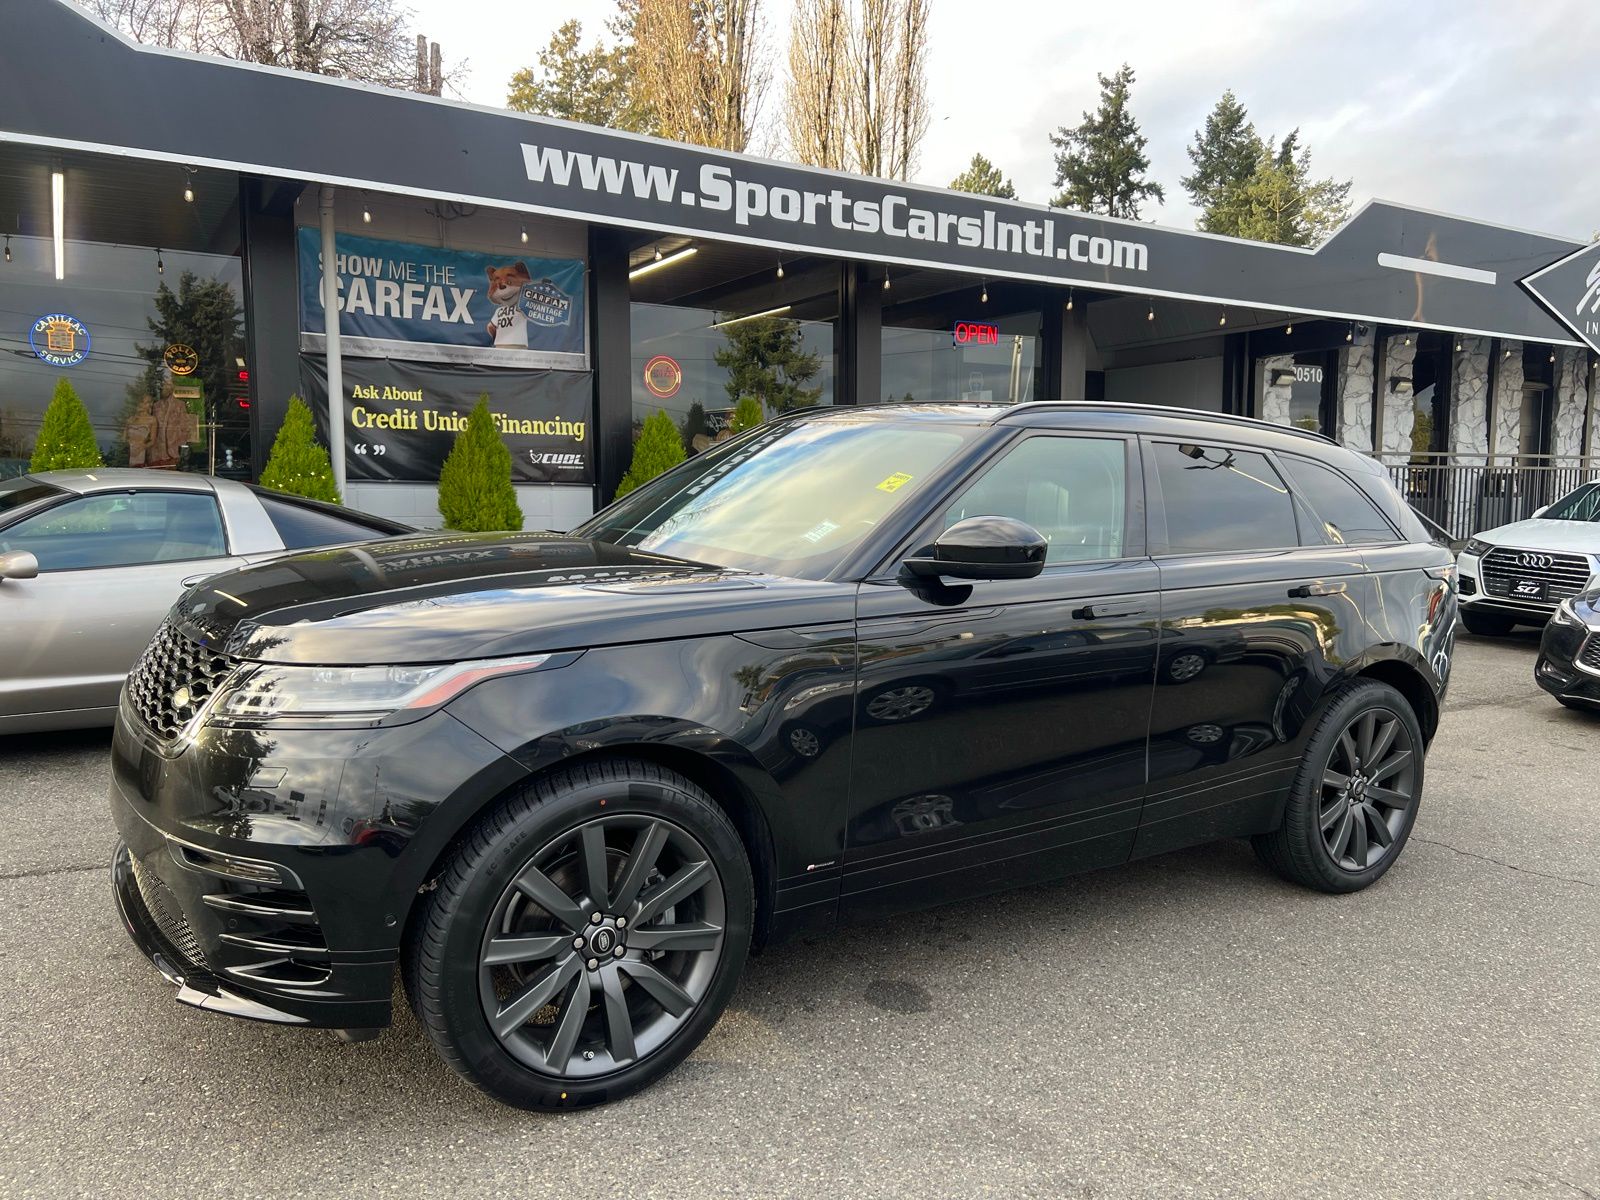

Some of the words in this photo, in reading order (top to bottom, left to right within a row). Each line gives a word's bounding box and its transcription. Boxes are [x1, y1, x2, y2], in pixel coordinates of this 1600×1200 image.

[520, 142, 1150, 272] www.SportsCarsIntl.com
[318, 252, 383, 277] HOW
[388, 259, 416, 282] ME
[421, 264, 456, 286] THE
[525, 290, 568, 310] CARFAX
[525, 301, 563, 318] ADVANTAGE
[497, 305, 515, 318] CAR
[528, 310, 555, 323] DEALER
[35, 315, 86, 335] CADILLAC
[497, 317, 513, 328] FOX
[956, 323, 998, 346] OPEN
[40, 350, 82, 365] SERVICE
[352, 384, 379, 400] Ask
[382, 386, 423, 402] About
[351, 406, 418, 430] Credit
[422, 410, 469, 432] Unio
[490, 413, 585, 442] Financing
